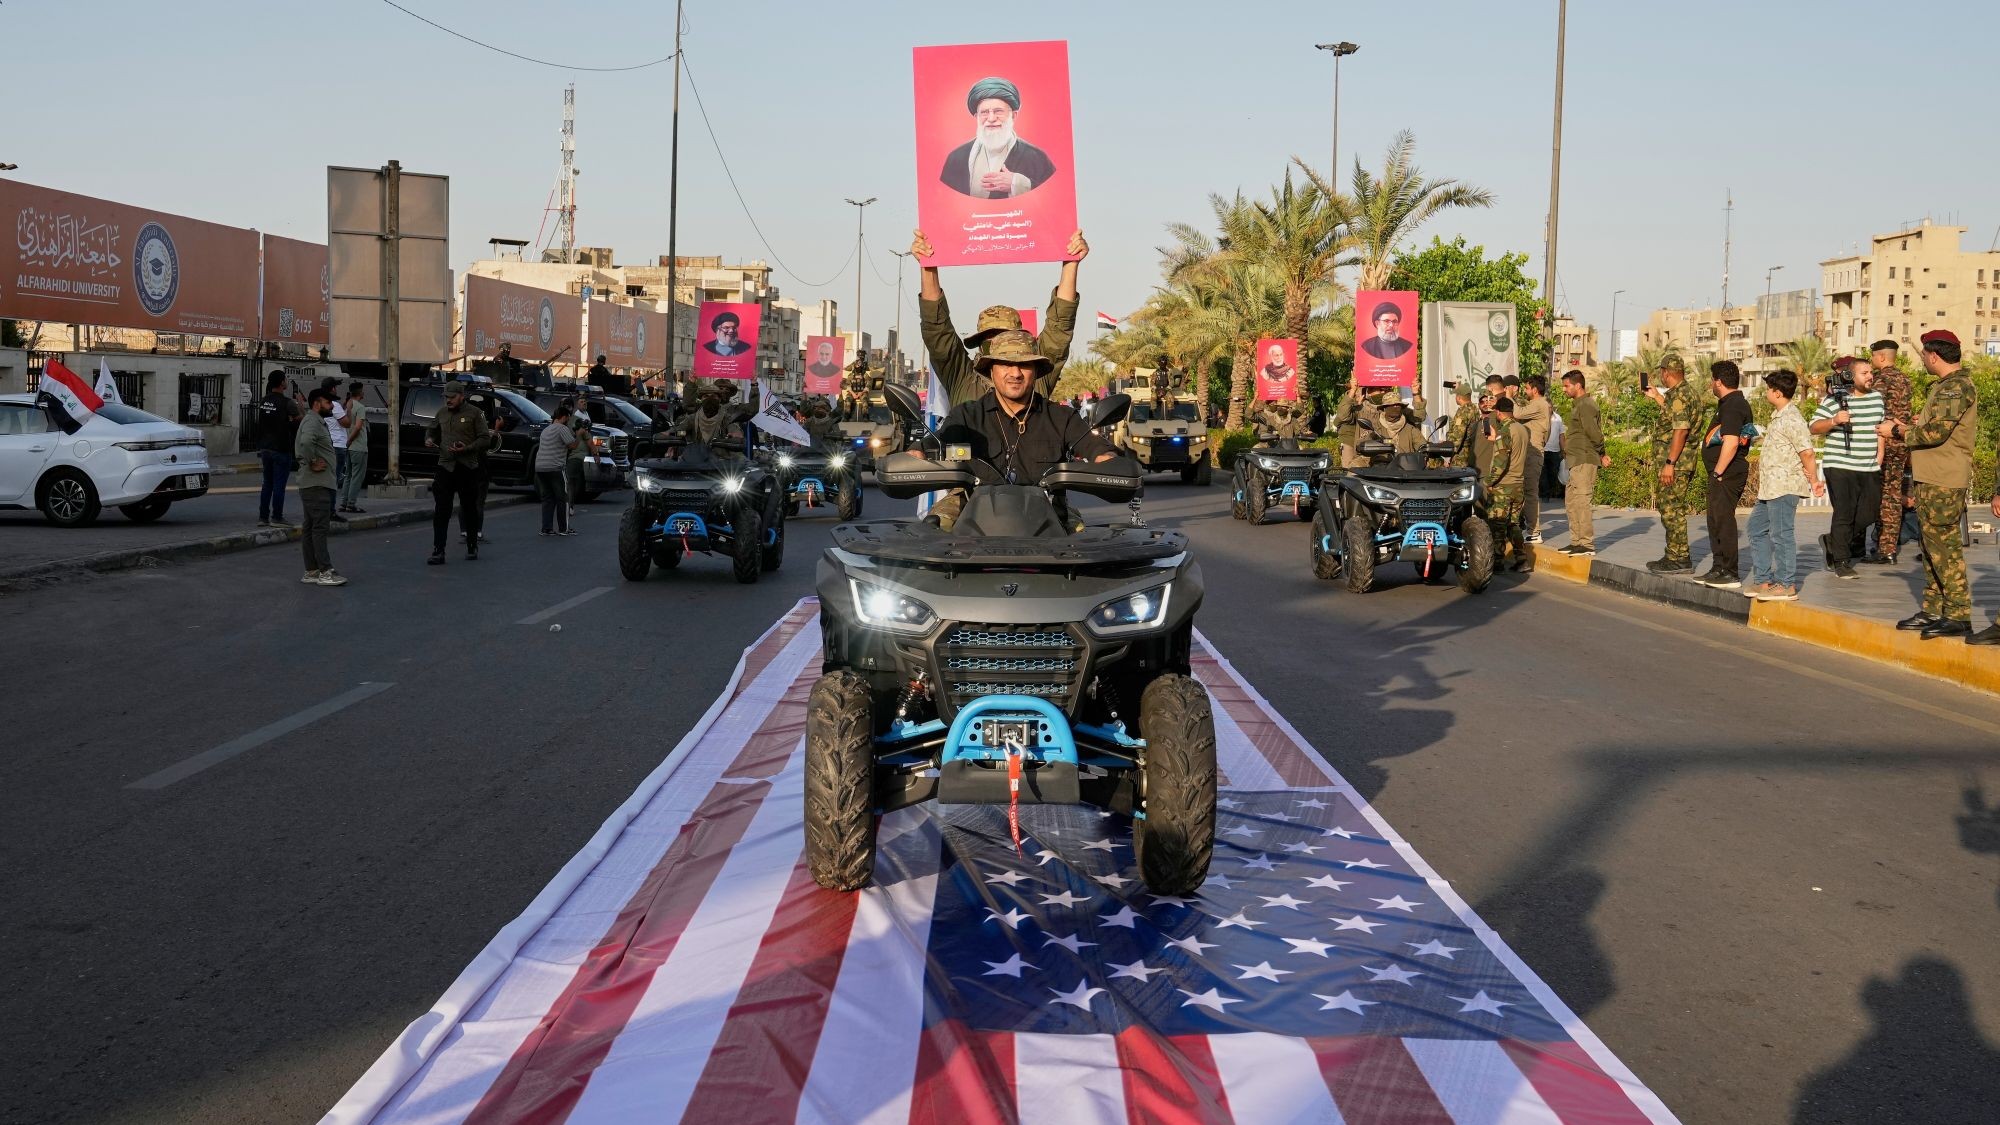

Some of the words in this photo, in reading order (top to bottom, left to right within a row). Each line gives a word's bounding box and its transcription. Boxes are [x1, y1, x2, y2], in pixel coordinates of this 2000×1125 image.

[17, 274, 71, 292] ALFARAHIDI
[72, 278, 121, 298] UNIVERSITY
[295, 319, 313, 334] 6155
[1095, 476, 1130, 485] SEGWAY
